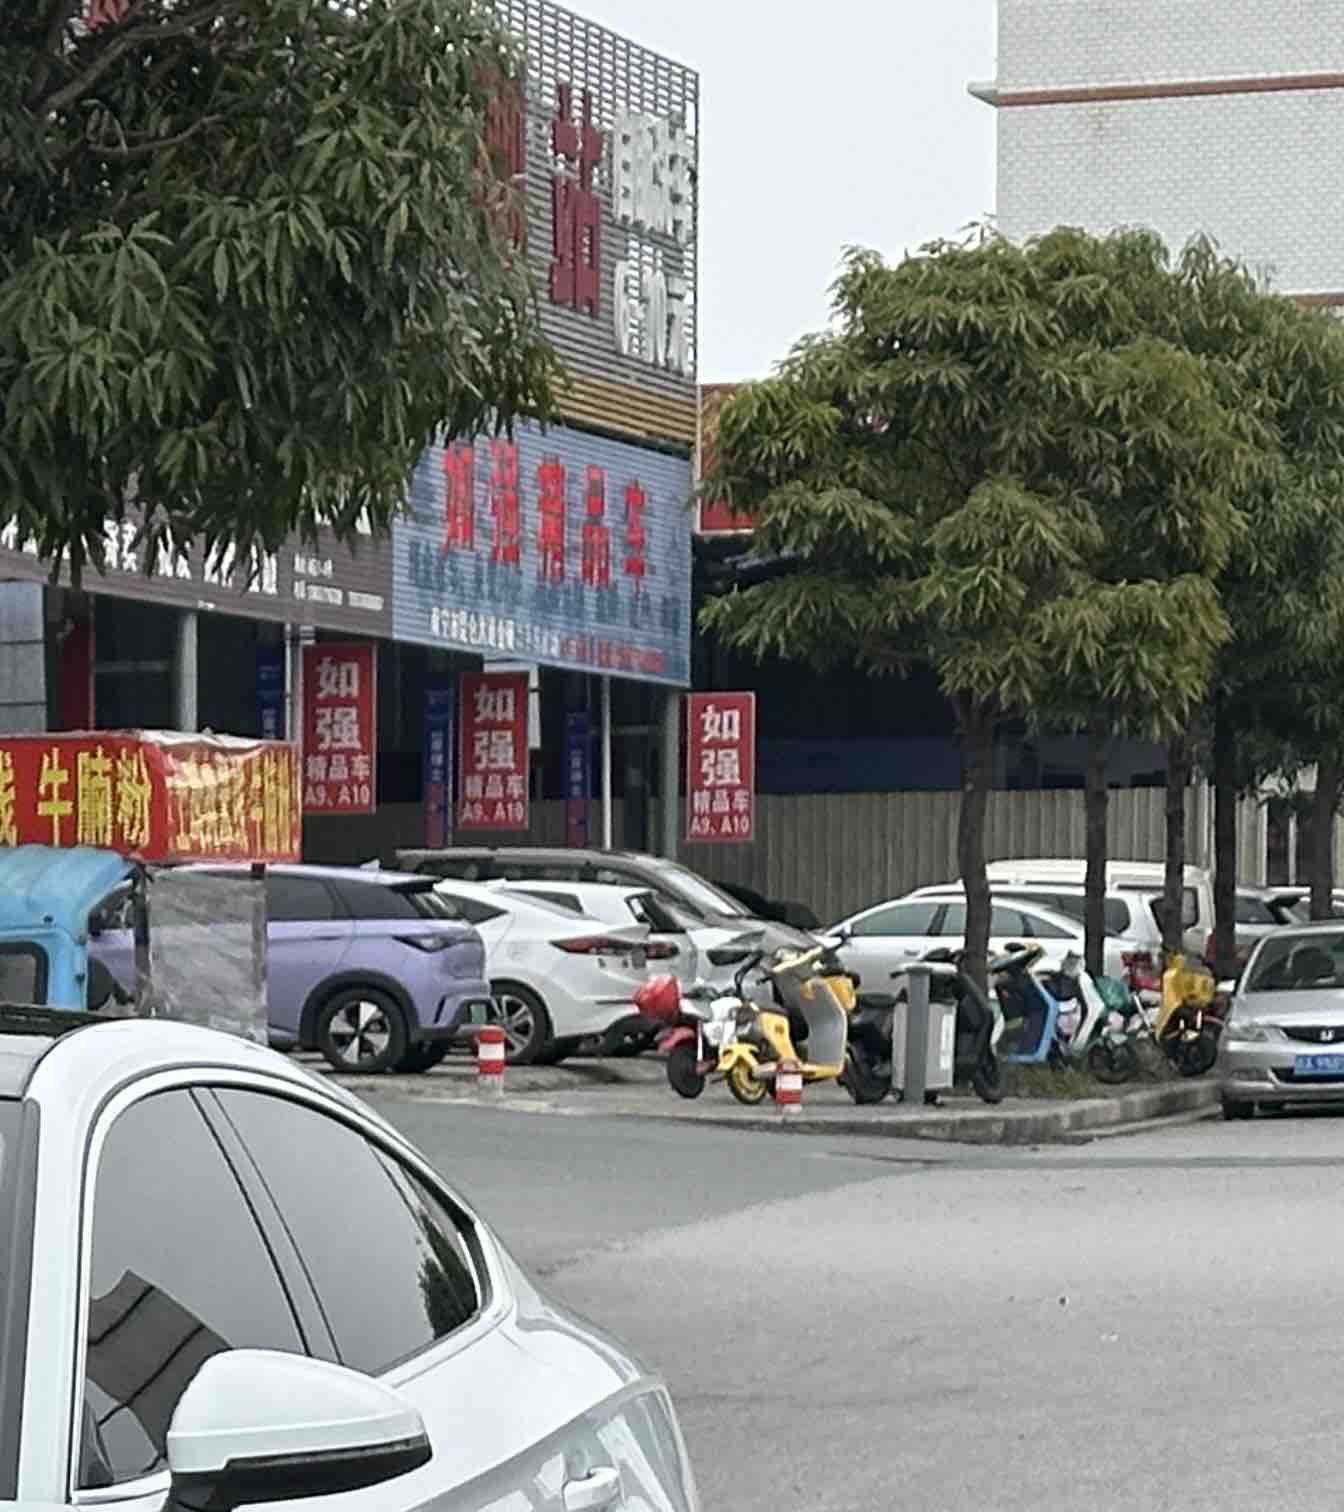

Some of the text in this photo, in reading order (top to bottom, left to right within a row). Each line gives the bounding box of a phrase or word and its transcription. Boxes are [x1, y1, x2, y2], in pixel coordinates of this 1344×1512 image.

[315, 656, 362, 751] 如强
[473, 683, 515, 771] 如强
[700, 703, 741, 787] 如强
[37, 744, 153, 848] 牛腩粉
[305, 753, 371, 781] 精品车
[464, 773, 525, 799] 精品车
[692, 788, 750, 814] 精品车
